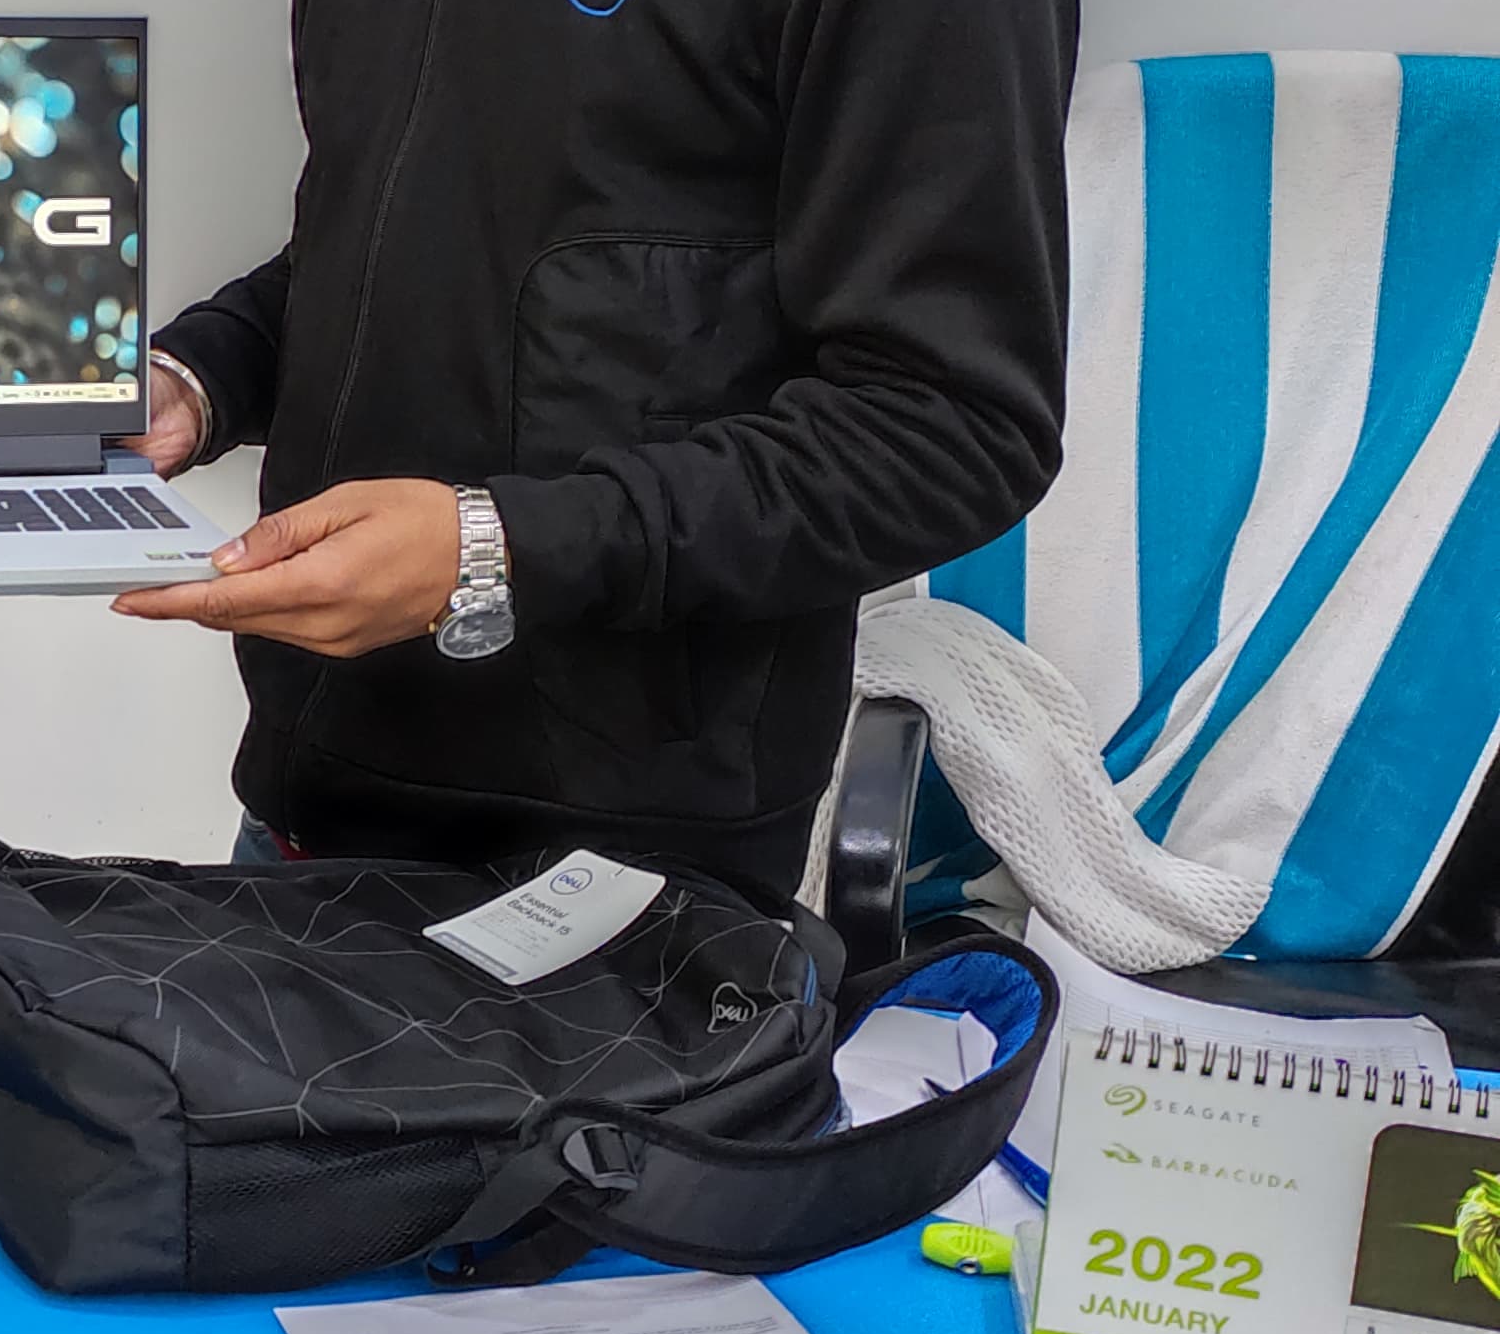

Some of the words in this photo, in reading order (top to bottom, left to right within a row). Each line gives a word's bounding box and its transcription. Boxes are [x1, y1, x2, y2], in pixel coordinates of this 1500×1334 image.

[507, 899, 556, 928] Backpack
[519, 892, 570, 918] Essential
[715, 1003, 749, 1022] DELL
[1153, 1099, 1262, 1128] SEAGATE
[1151, 1155, 1299, 1192] BARRACUDA
[1084, 1228, 1263, 1300] 2022
